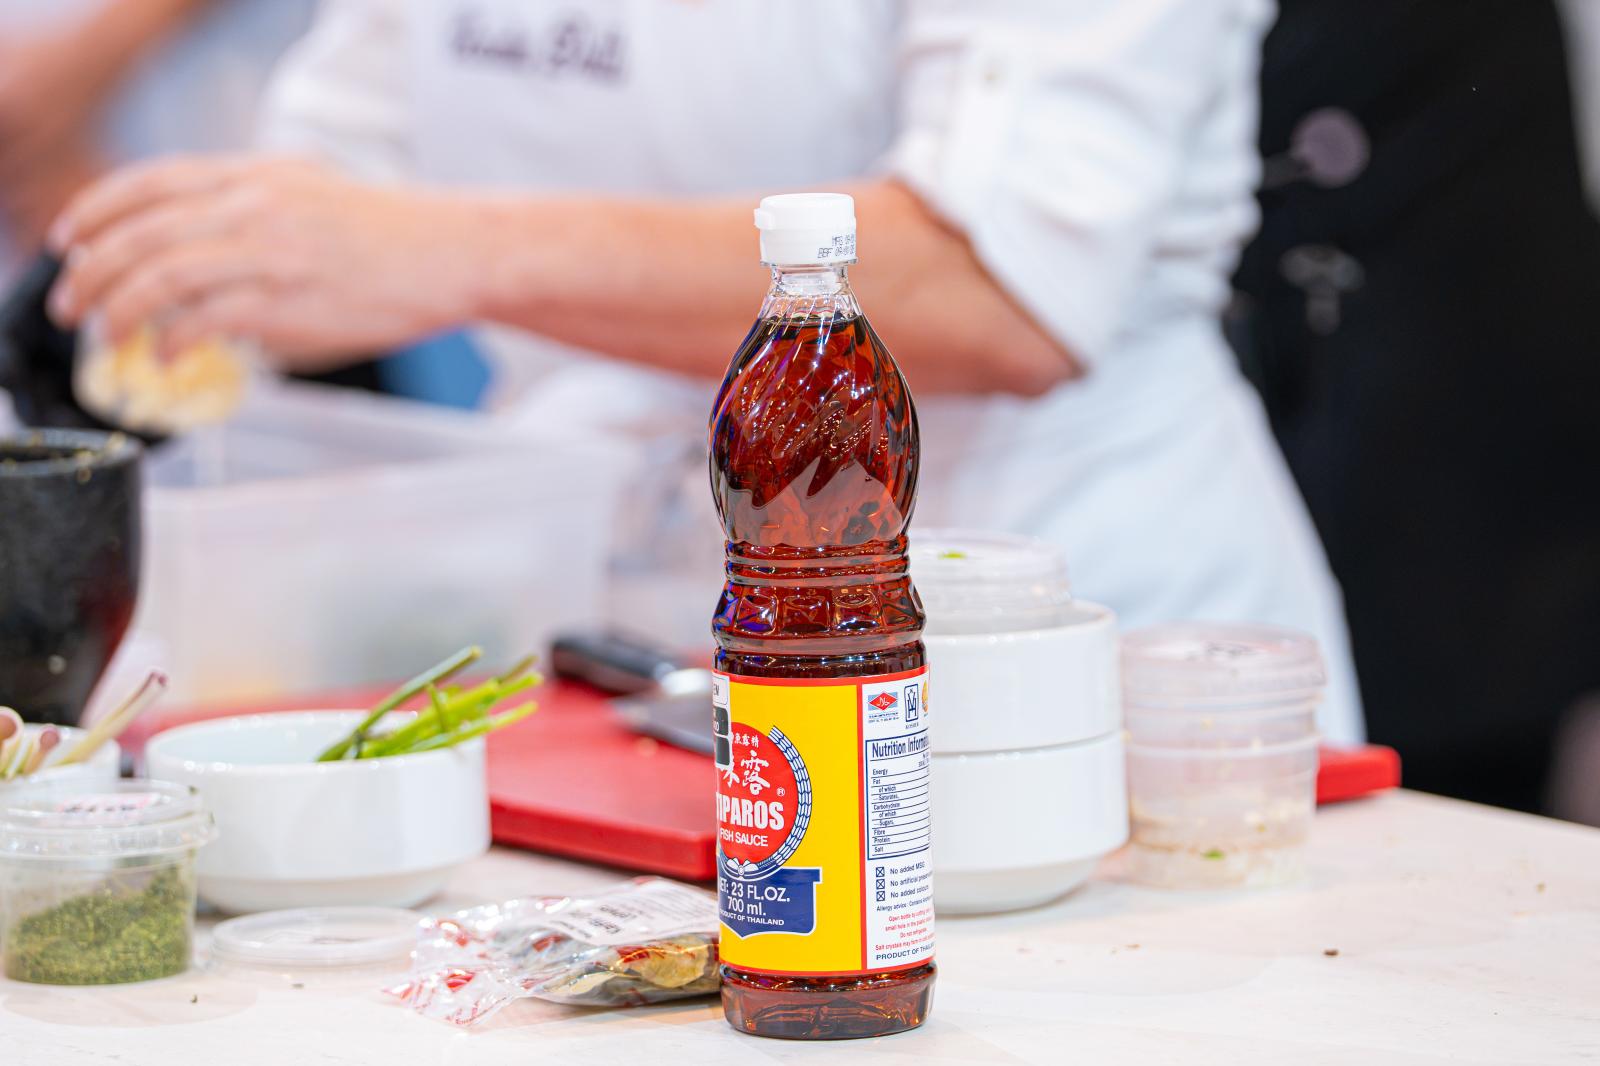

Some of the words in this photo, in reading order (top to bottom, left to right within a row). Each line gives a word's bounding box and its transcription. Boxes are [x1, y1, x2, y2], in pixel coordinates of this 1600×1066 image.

[872, 741, 906, 758] Nutrition
[872, 768, 888, 776] Energy
[735, 832, 768, 847] SAUCE
[899, 864, 914, 873] added
[731, 881, 744, 898] 23
[900, 888, 915, 897] added
[727, 896, 744, 913] 700
[747, 902, 766, 916] ml.
[747, 916, 785, 926] THAILAND
[876, 949, 910, 960] PRODUCT
